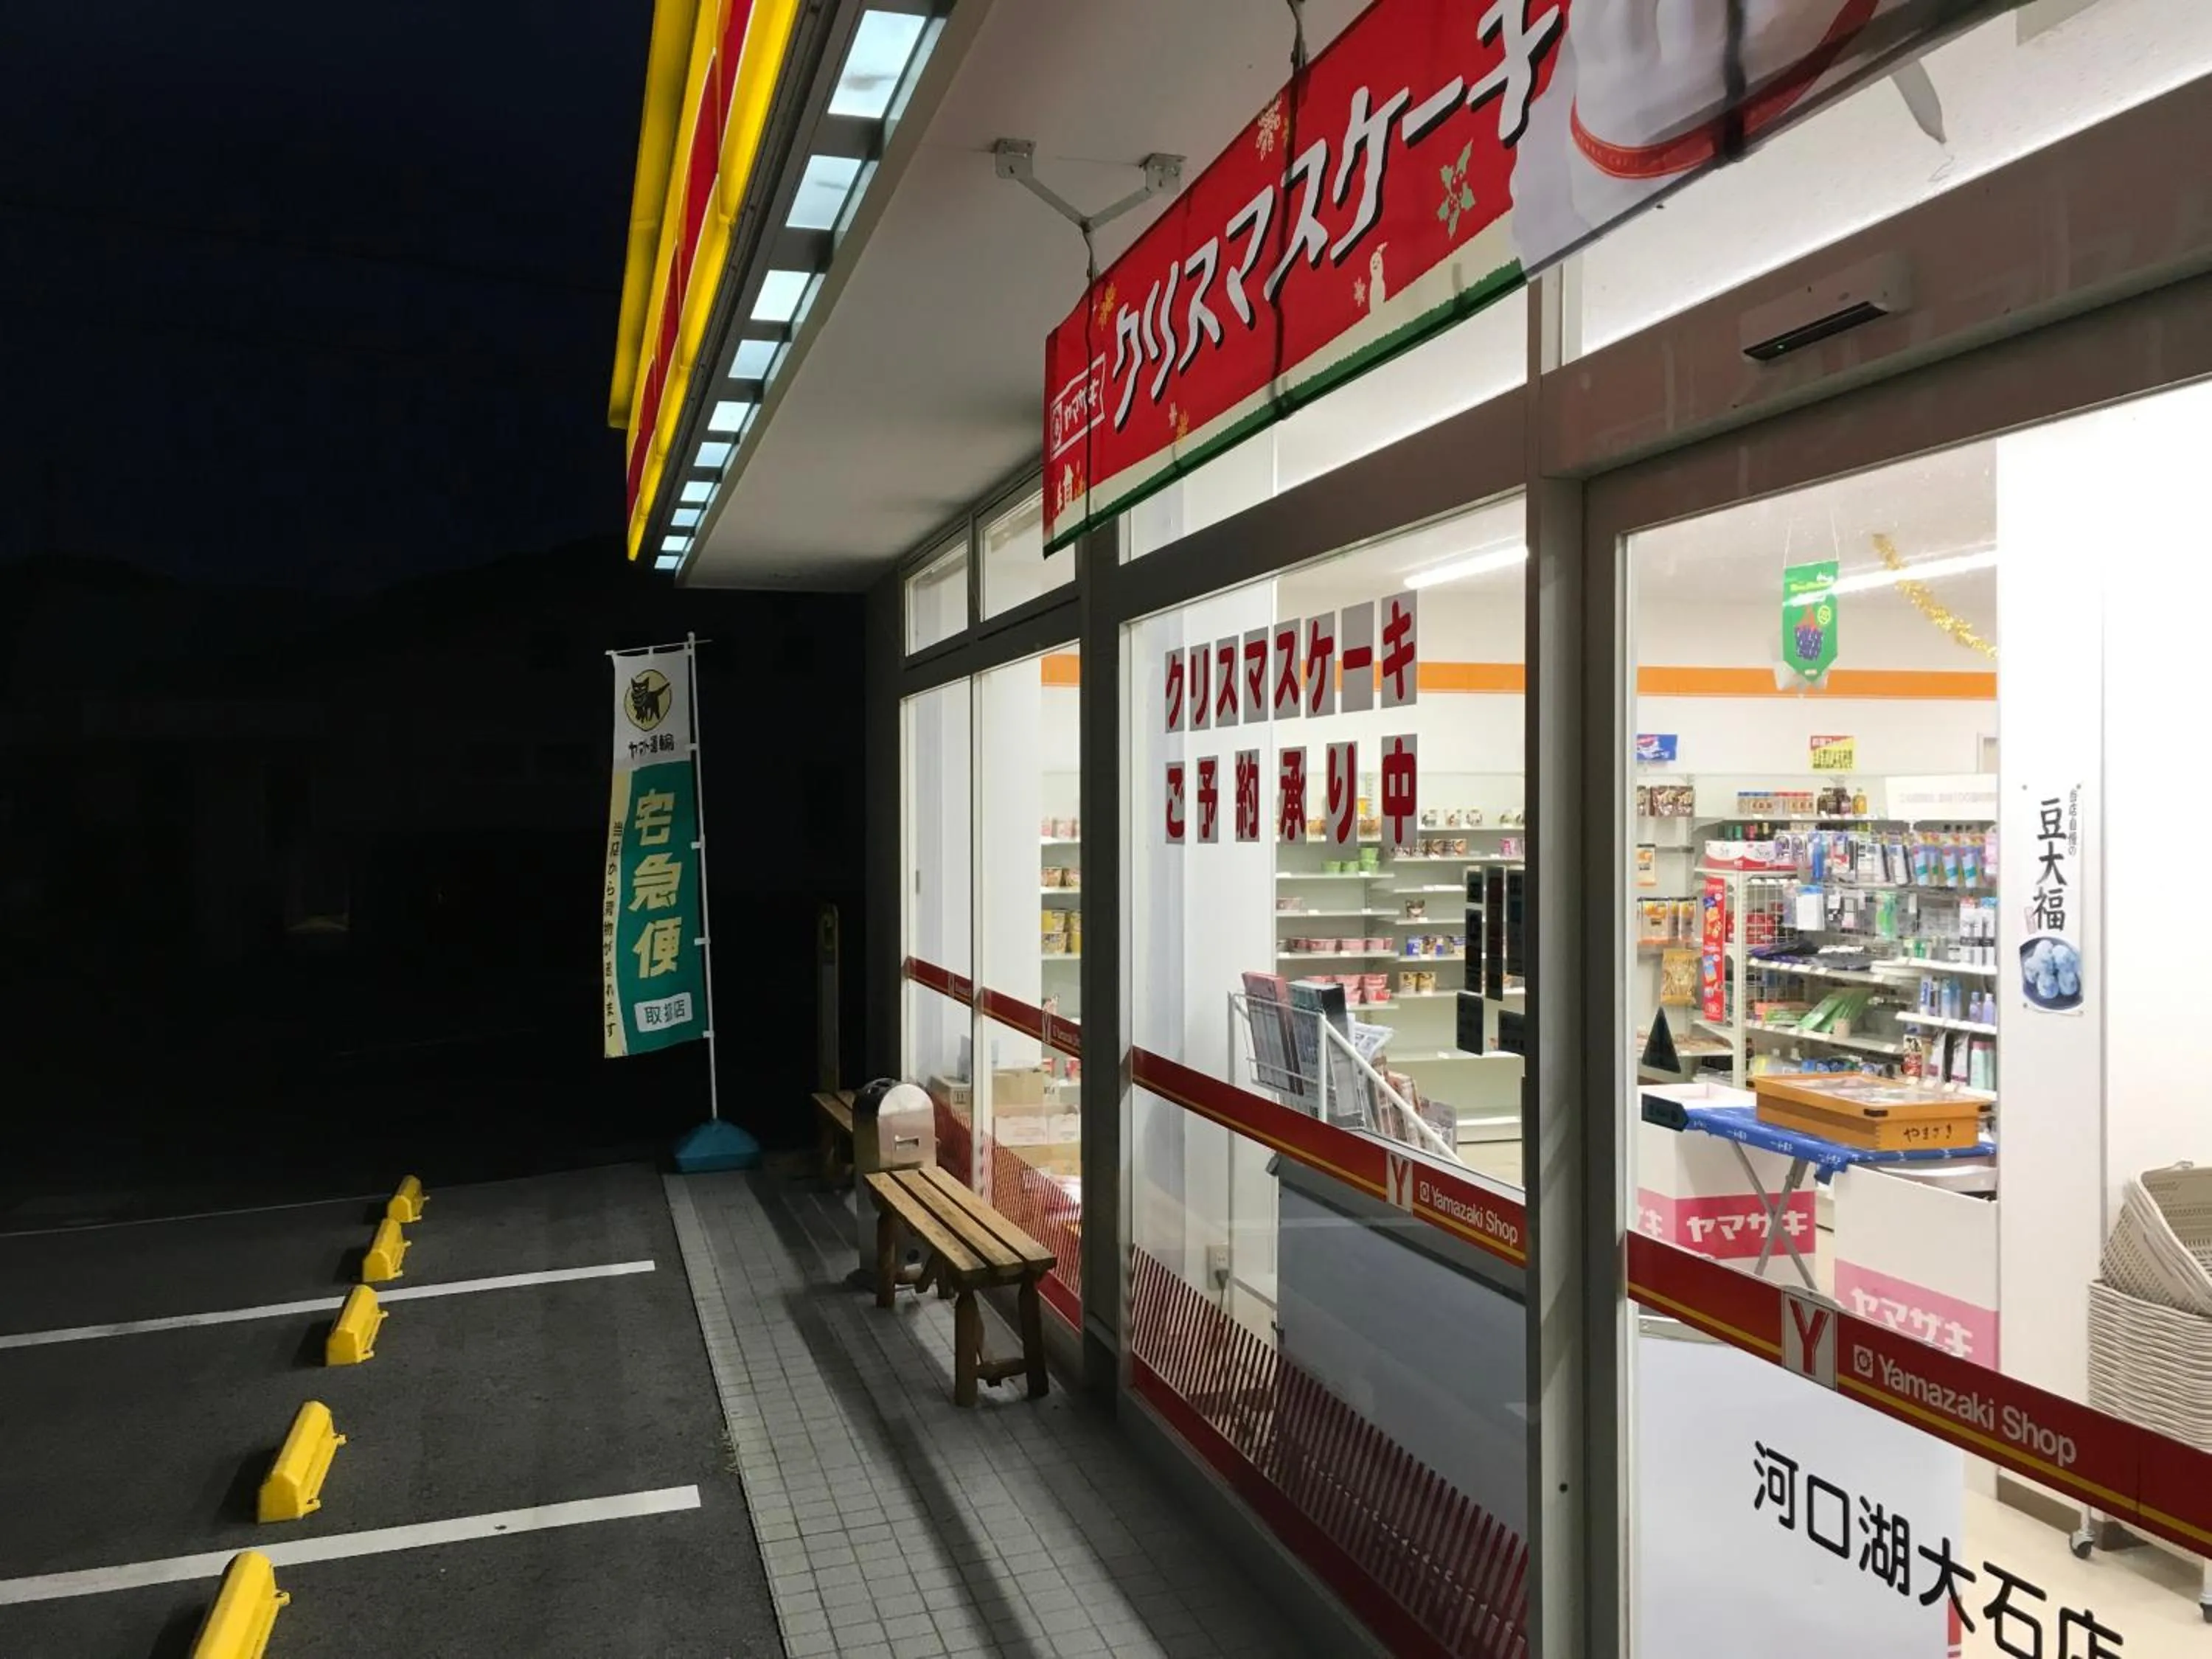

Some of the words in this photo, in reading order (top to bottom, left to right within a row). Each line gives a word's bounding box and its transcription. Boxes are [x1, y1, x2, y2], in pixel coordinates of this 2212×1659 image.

[1113, 0, 1560, 431] クリスマスケーキ
[1166, 600, 1415, 728] クリスマスケーキ
[1166, 737, 1416, 844] ご予約承り中
[628, 788, 682, 978] 宅急便
[2033, 797, 2068, 931] 豆大福
[1390, 1154, 1409, 1205] Y
[1430, 1185, 1483, 1228] Yamazaki
[1486, 1211, 1518, 1247] Shop
[1789, 1298, 1830, 1377] Y
[1850, 1287, 1973, 1359] ヤマザキ
[1877, 1354, 1995, 1431] Yamazaki
[2002, 1404, 2078, 1467] Shop
